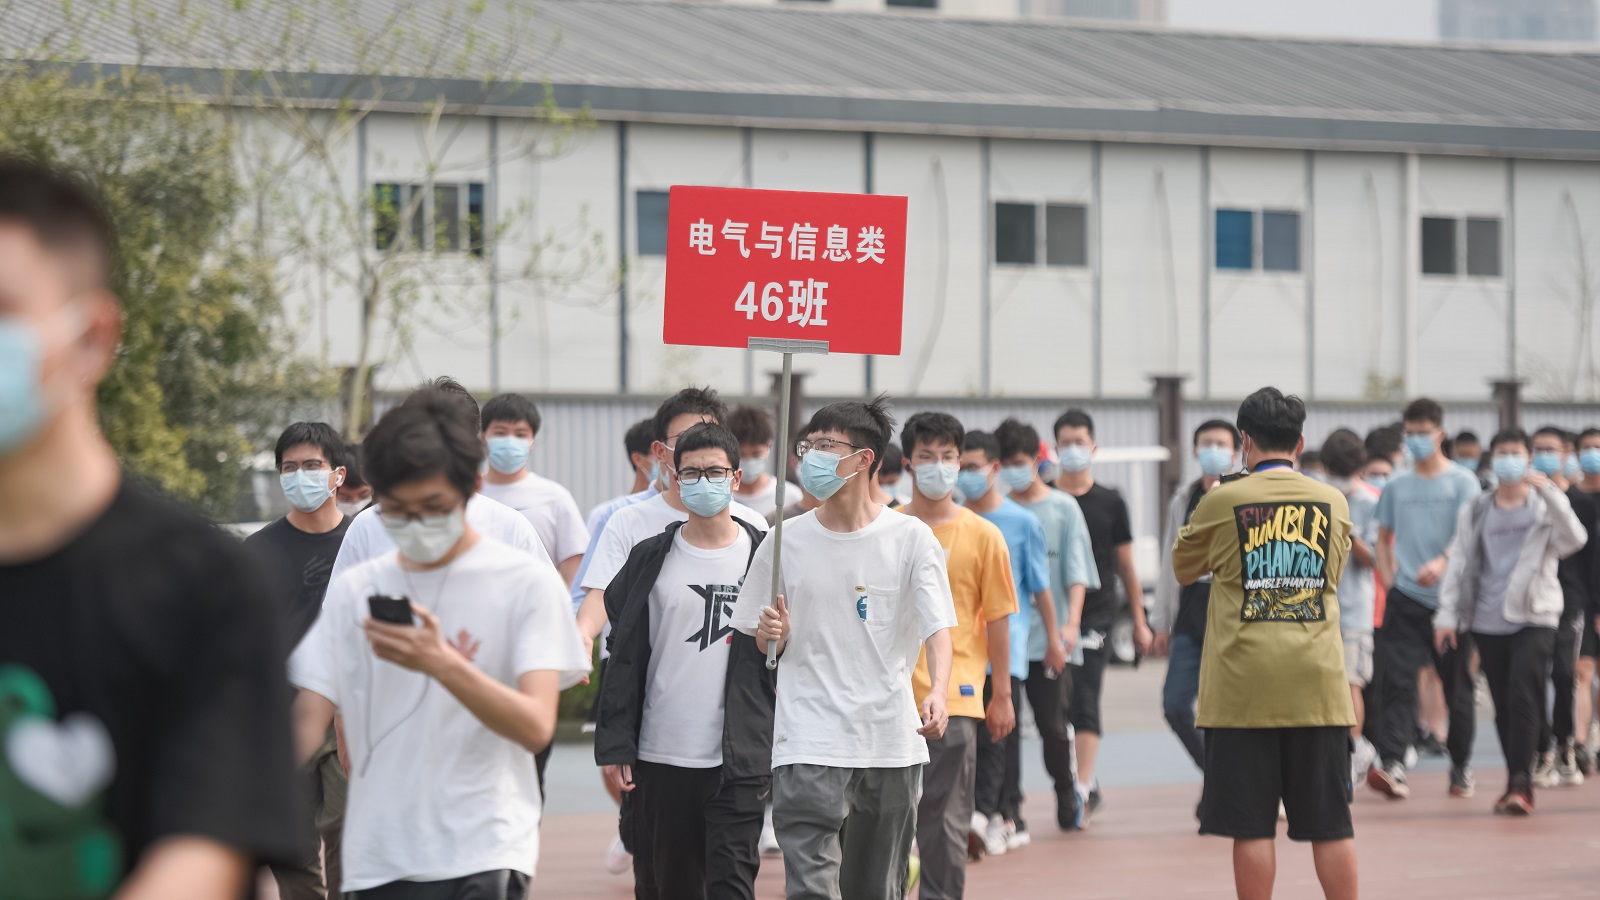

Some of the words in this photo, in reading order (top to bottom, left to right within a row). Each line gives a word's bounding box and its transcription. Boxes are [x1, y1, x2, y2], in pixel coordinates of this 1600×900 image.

[689, 218, 886, 264] 电气与信息类
[734, 278, 829, 327] 46班
[1244, 505, 1328, 560] JUMBLE
[1246, 540, 1323, 580] PHANTOM
